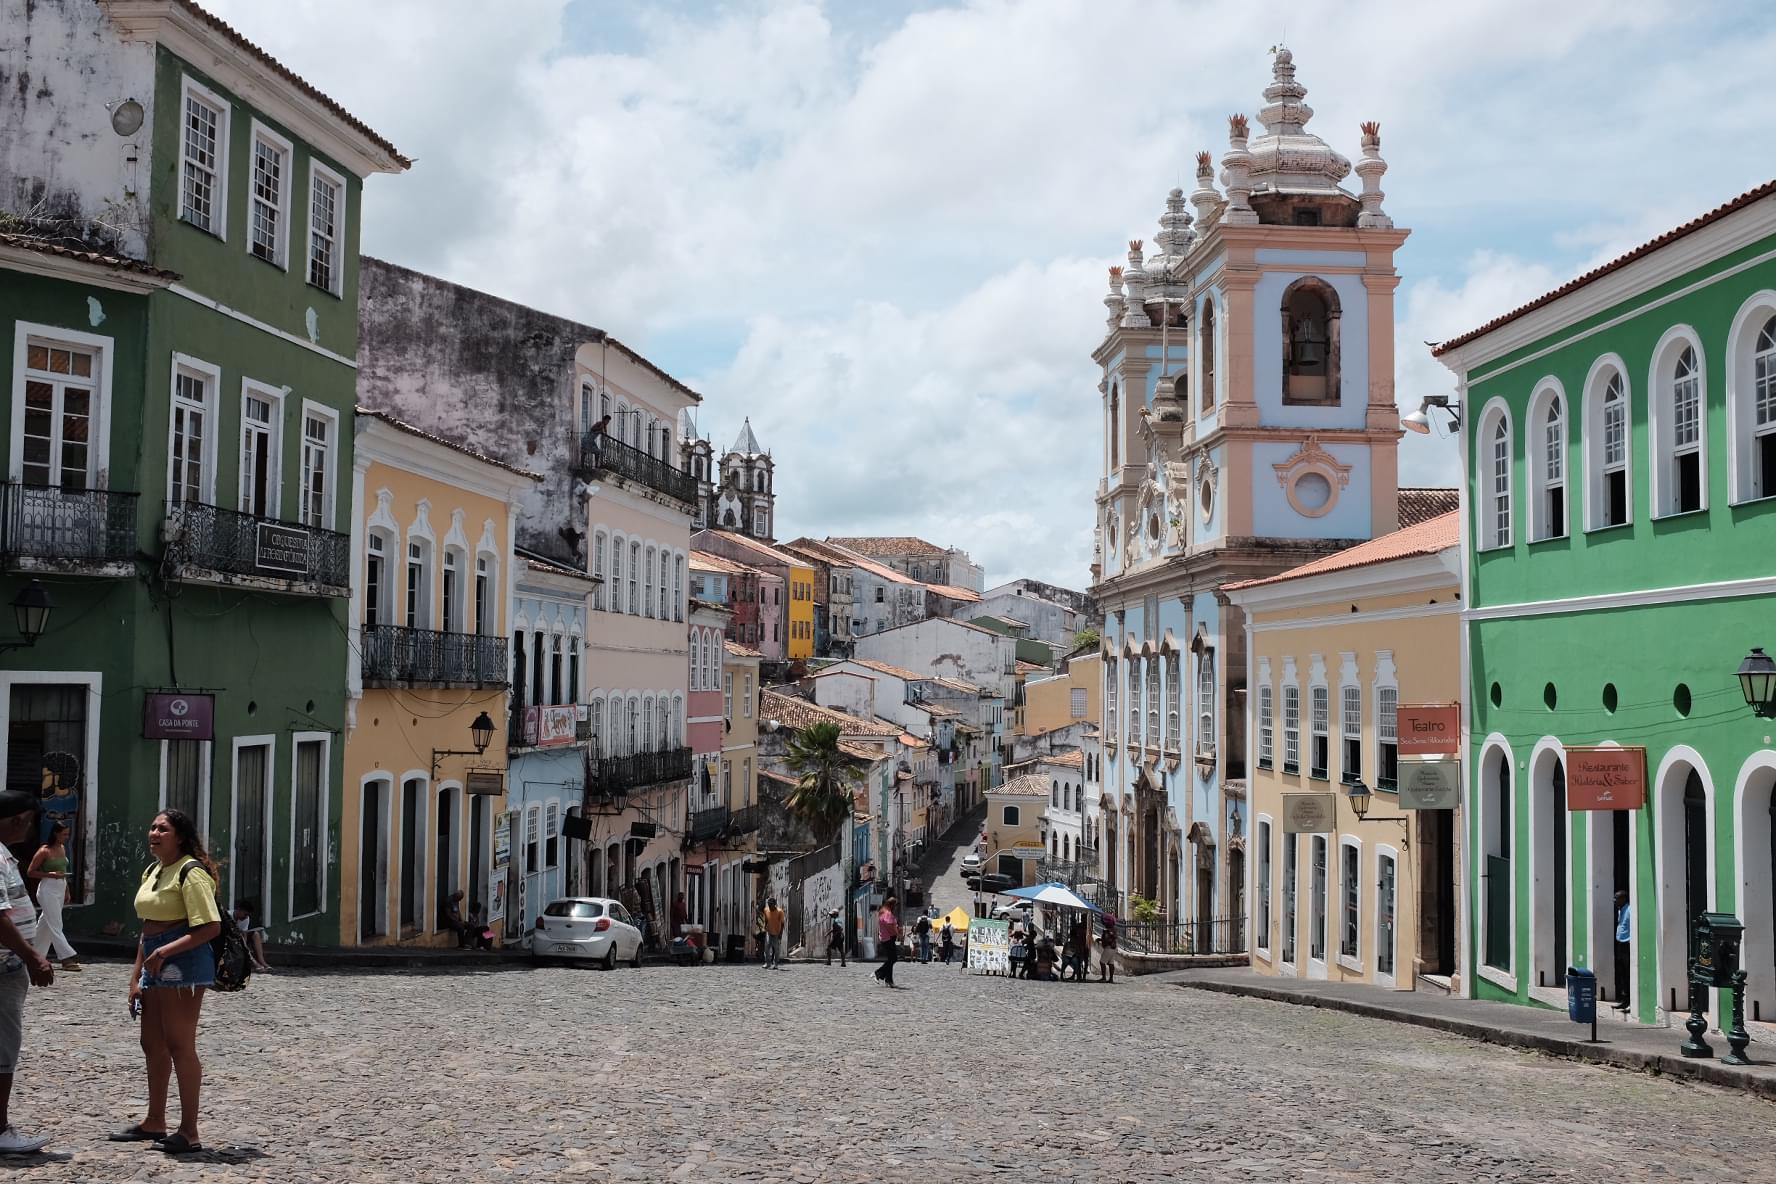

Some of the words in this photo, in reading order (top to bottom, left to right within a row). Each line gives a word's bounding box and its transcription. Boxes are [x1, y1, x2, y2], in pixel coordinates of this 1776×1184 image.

[158, 719, 173, 727] CASA
[173, 719, 182, 727] DA
[182, 719, 200, 728] PONTE
[1407, 718, 1446, 732] Teatro
[1578, 762, 1631, 772] Restaurante
